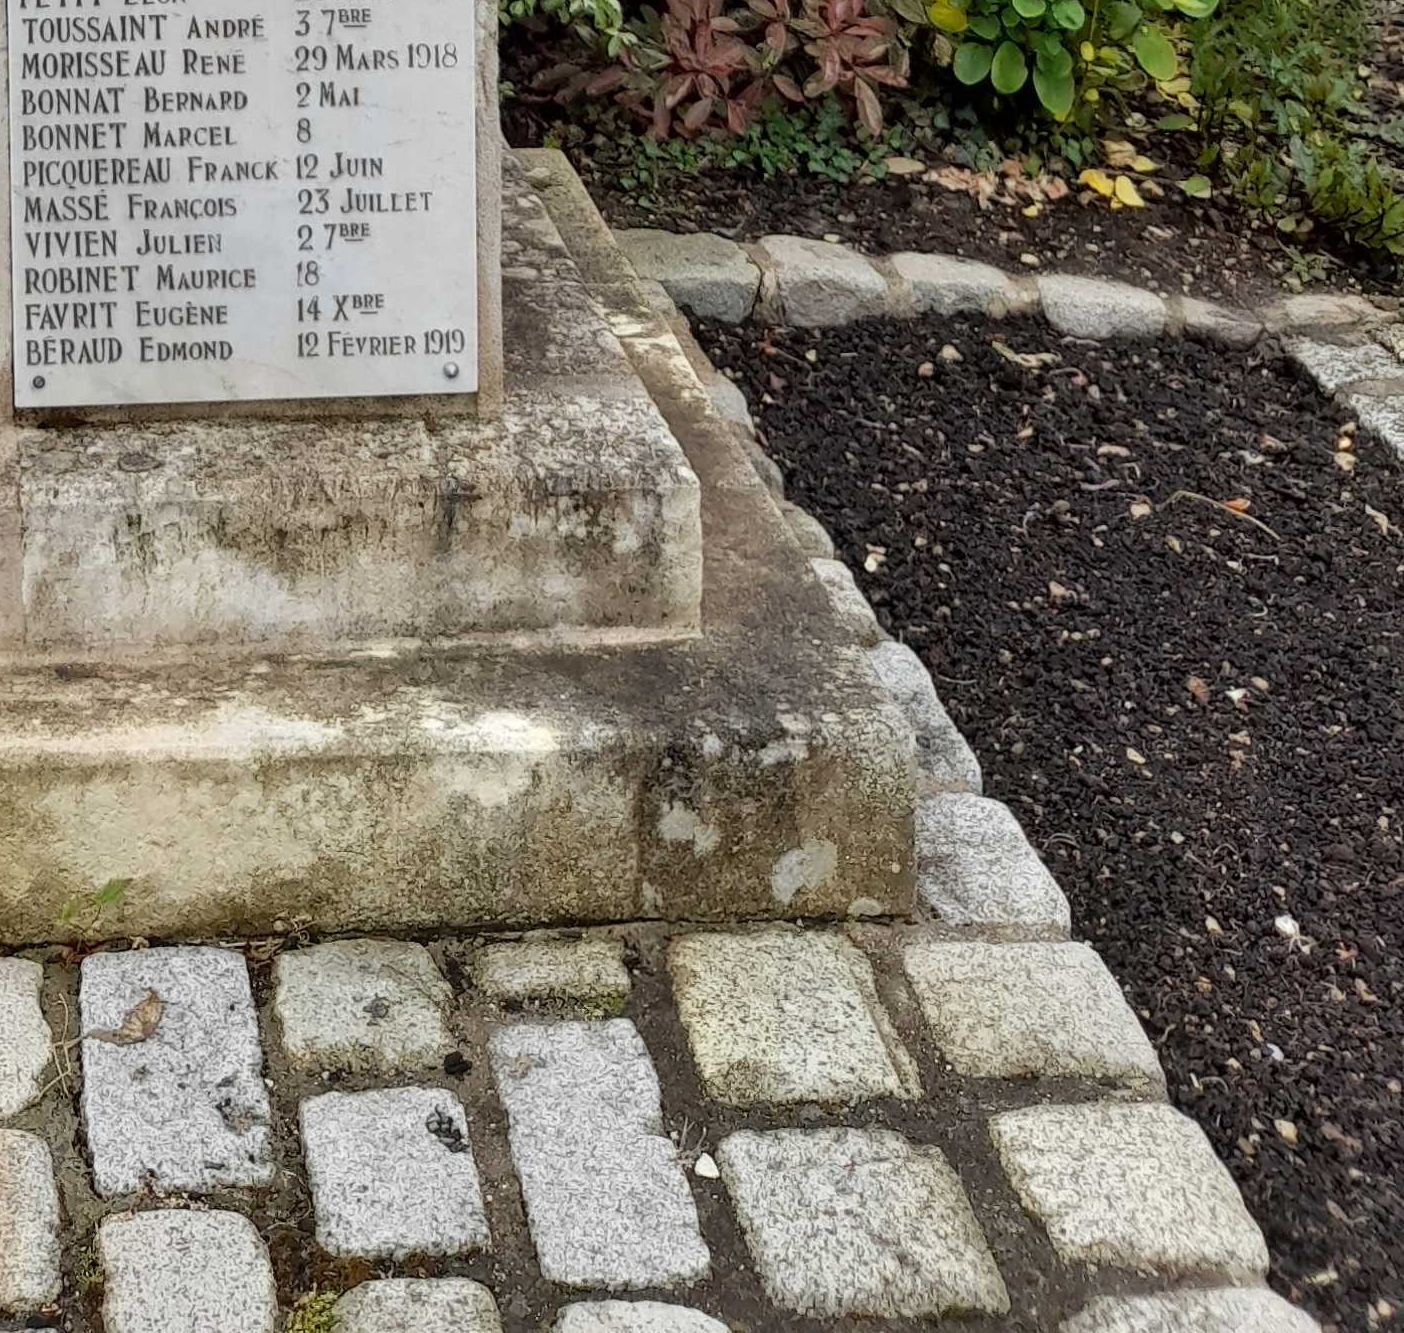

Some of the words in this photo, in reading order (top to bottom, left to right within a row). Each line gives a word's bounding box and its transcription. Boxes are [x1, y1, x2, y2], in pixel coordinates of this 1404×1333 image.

[22, 14, 167, 44] TOUSSAINT
[187, 15, 264, 41] ANDRÉ
[22, 50, 166, 79] MORISSEAU
[182, 49, 246, 75] RENÉ
[336, 44, 399, 71] MARS
[22, 87, 125, 115] BONNAT
[144, 86, 248, 113] BERNARD
[319, 81, 359, 108] MAI
[23, 122, 127, 151] BONNET
[144, 122, 237, 149] MARCEL
[24, 157, 170, 189] PICQUEREAU
[188, 156, 278, 182] FRANCK
[296, 153, 318, 180] 12
[330, 152, 383, 180] JUIN
[24, 189, 110, 223] MASSÉ
[128, 194, 237, 220] FRANÇOIS
[298, 188, 329, 215] 23
[340, 188, 432, 214] JUILLET
[25, 230, 117, 259] VIVIEN
[136, 229, 221, 256] JULIEN
[25, 265, 139, 294] ROBINET
[157, 264, 256, 291] MAURICE
[25, 302, 117, 330] FAVRIT
[136, 301, 228, 328] EUGÈNE
[298, 296, 321, 322] 14
[27, 337, 122, 366] BÉRAUD
[140, 337, 233, 363] EDMOND
[298, 332, 319, 358] 12
